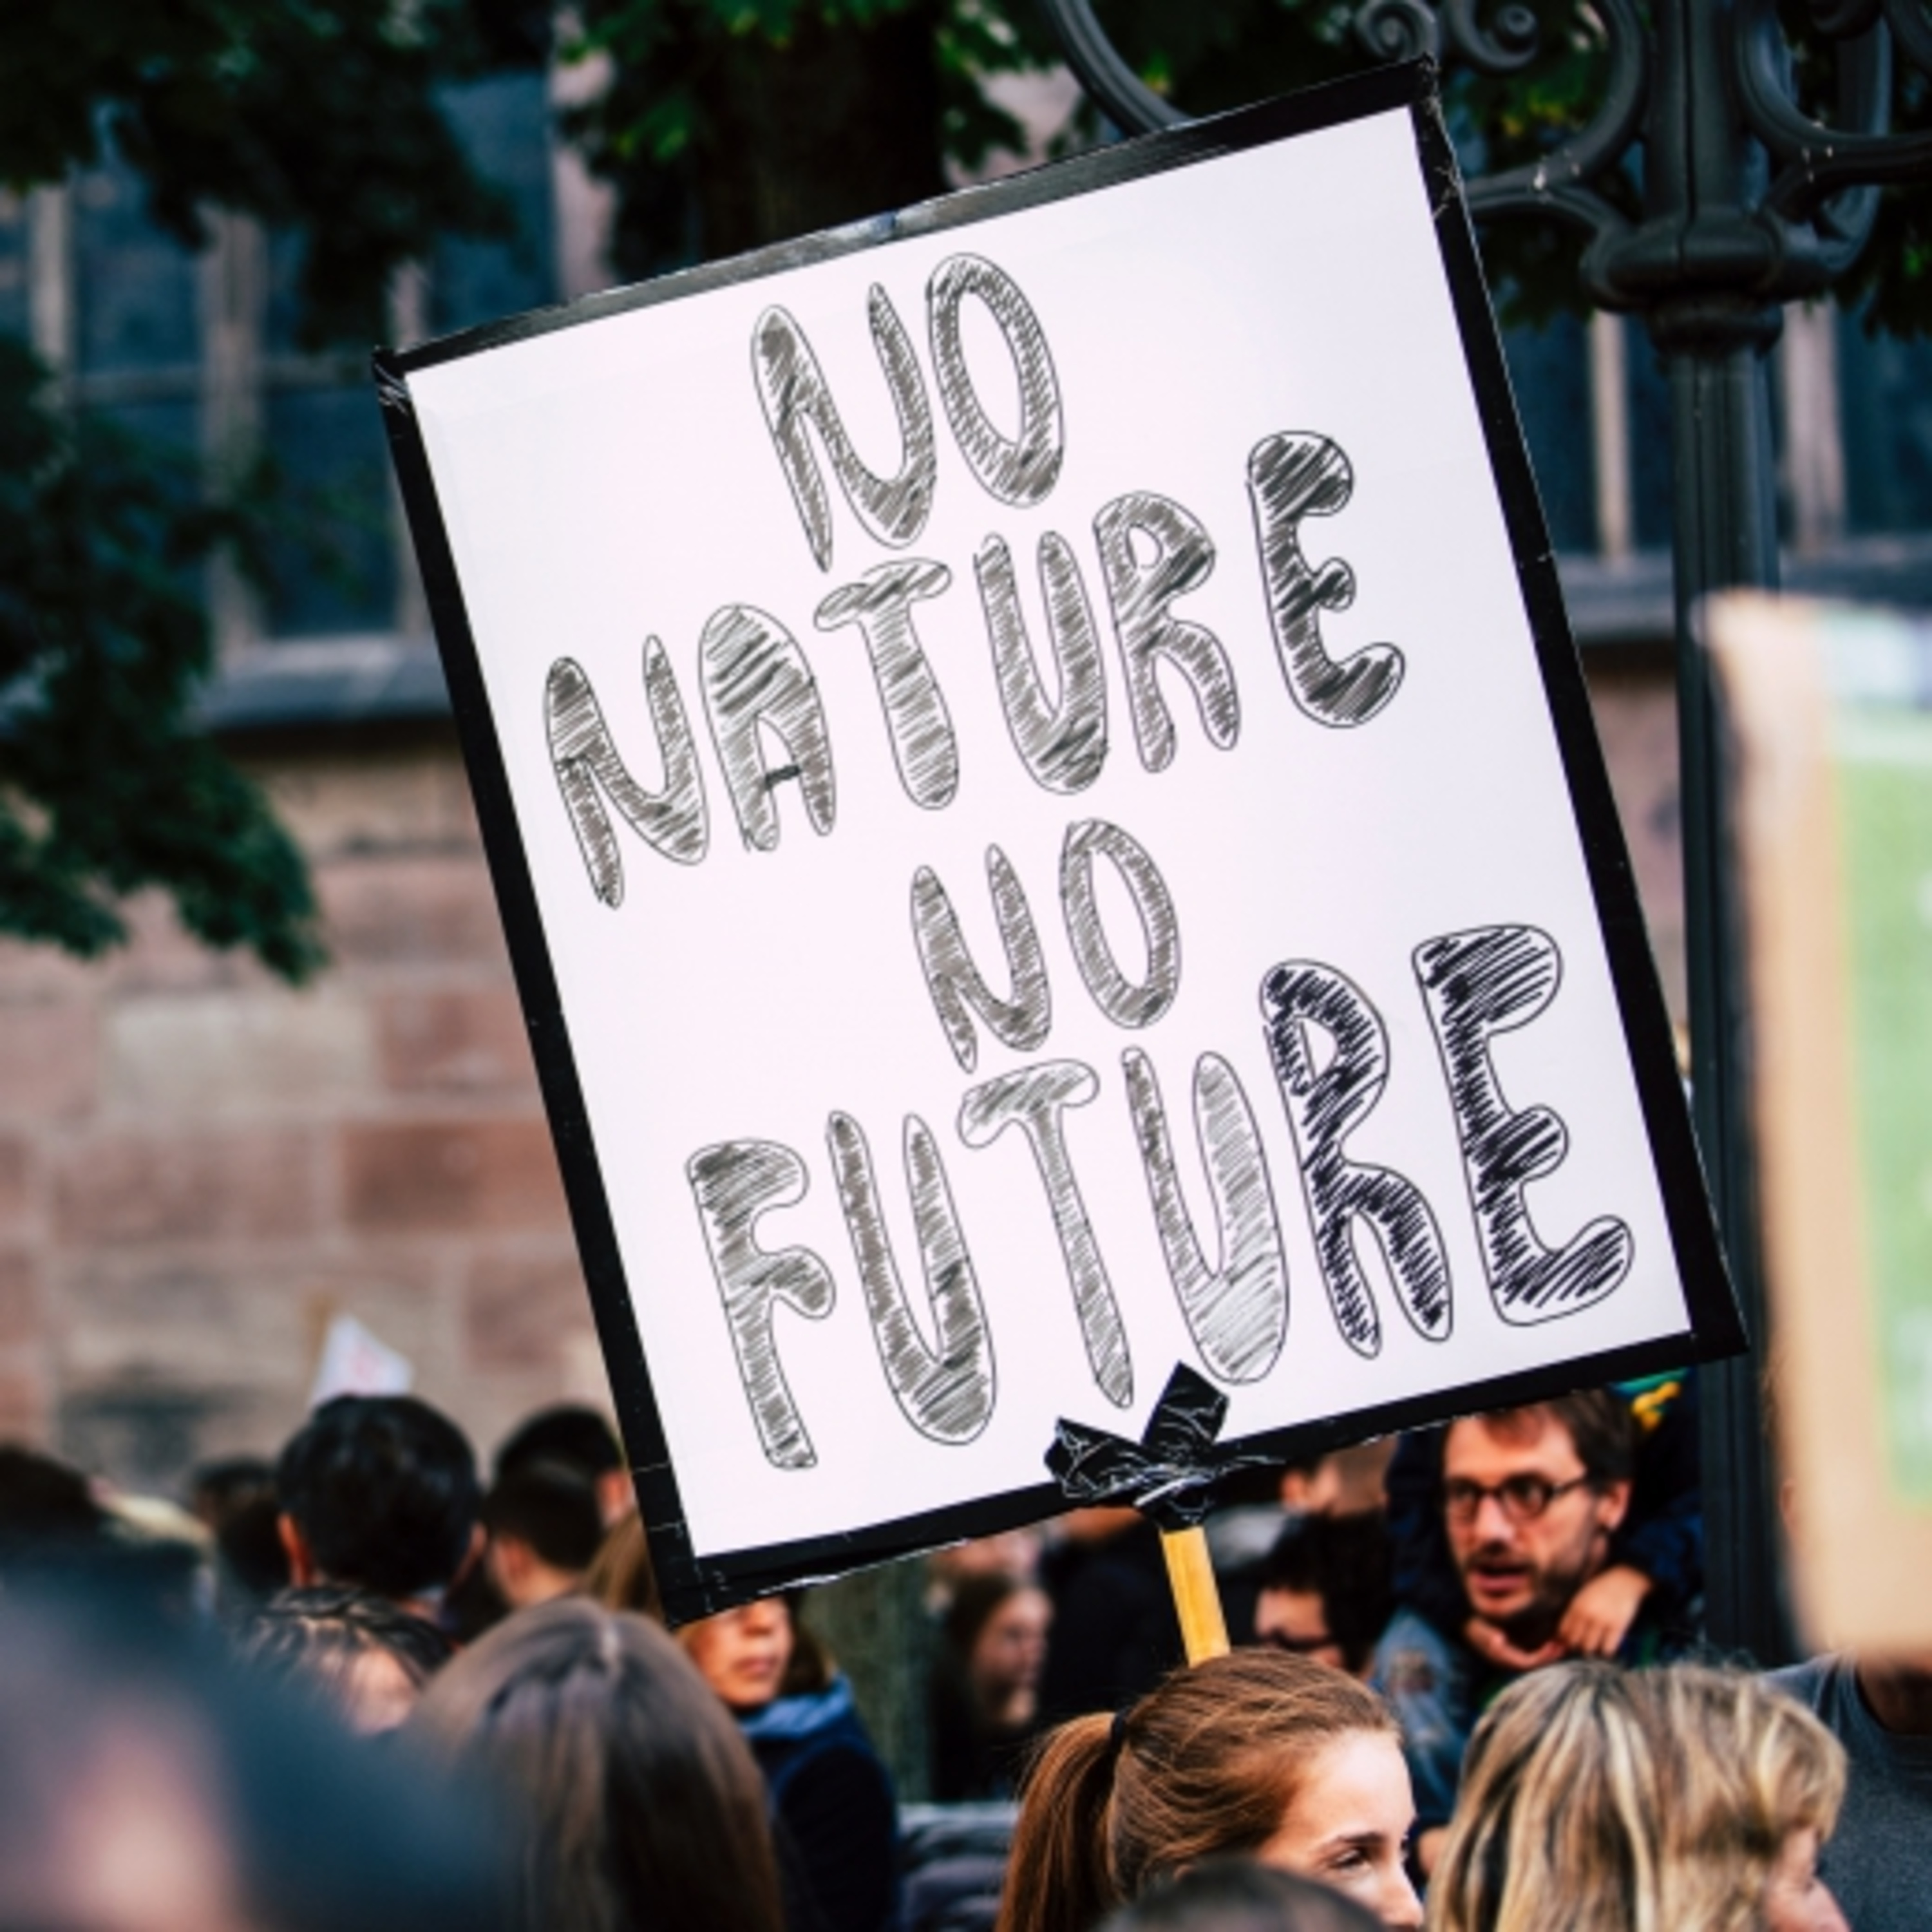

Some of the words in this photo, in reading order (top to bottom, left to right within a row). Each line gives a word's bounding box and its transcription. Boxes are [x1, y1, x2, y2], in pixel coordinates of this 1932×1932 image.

[752, 252, 1064, 572] NO
[544, 430, 1406, 909] NATURE
[909, 819, 1181, 1072] NO
[685, 923, 1636, 1471] FUTURE
